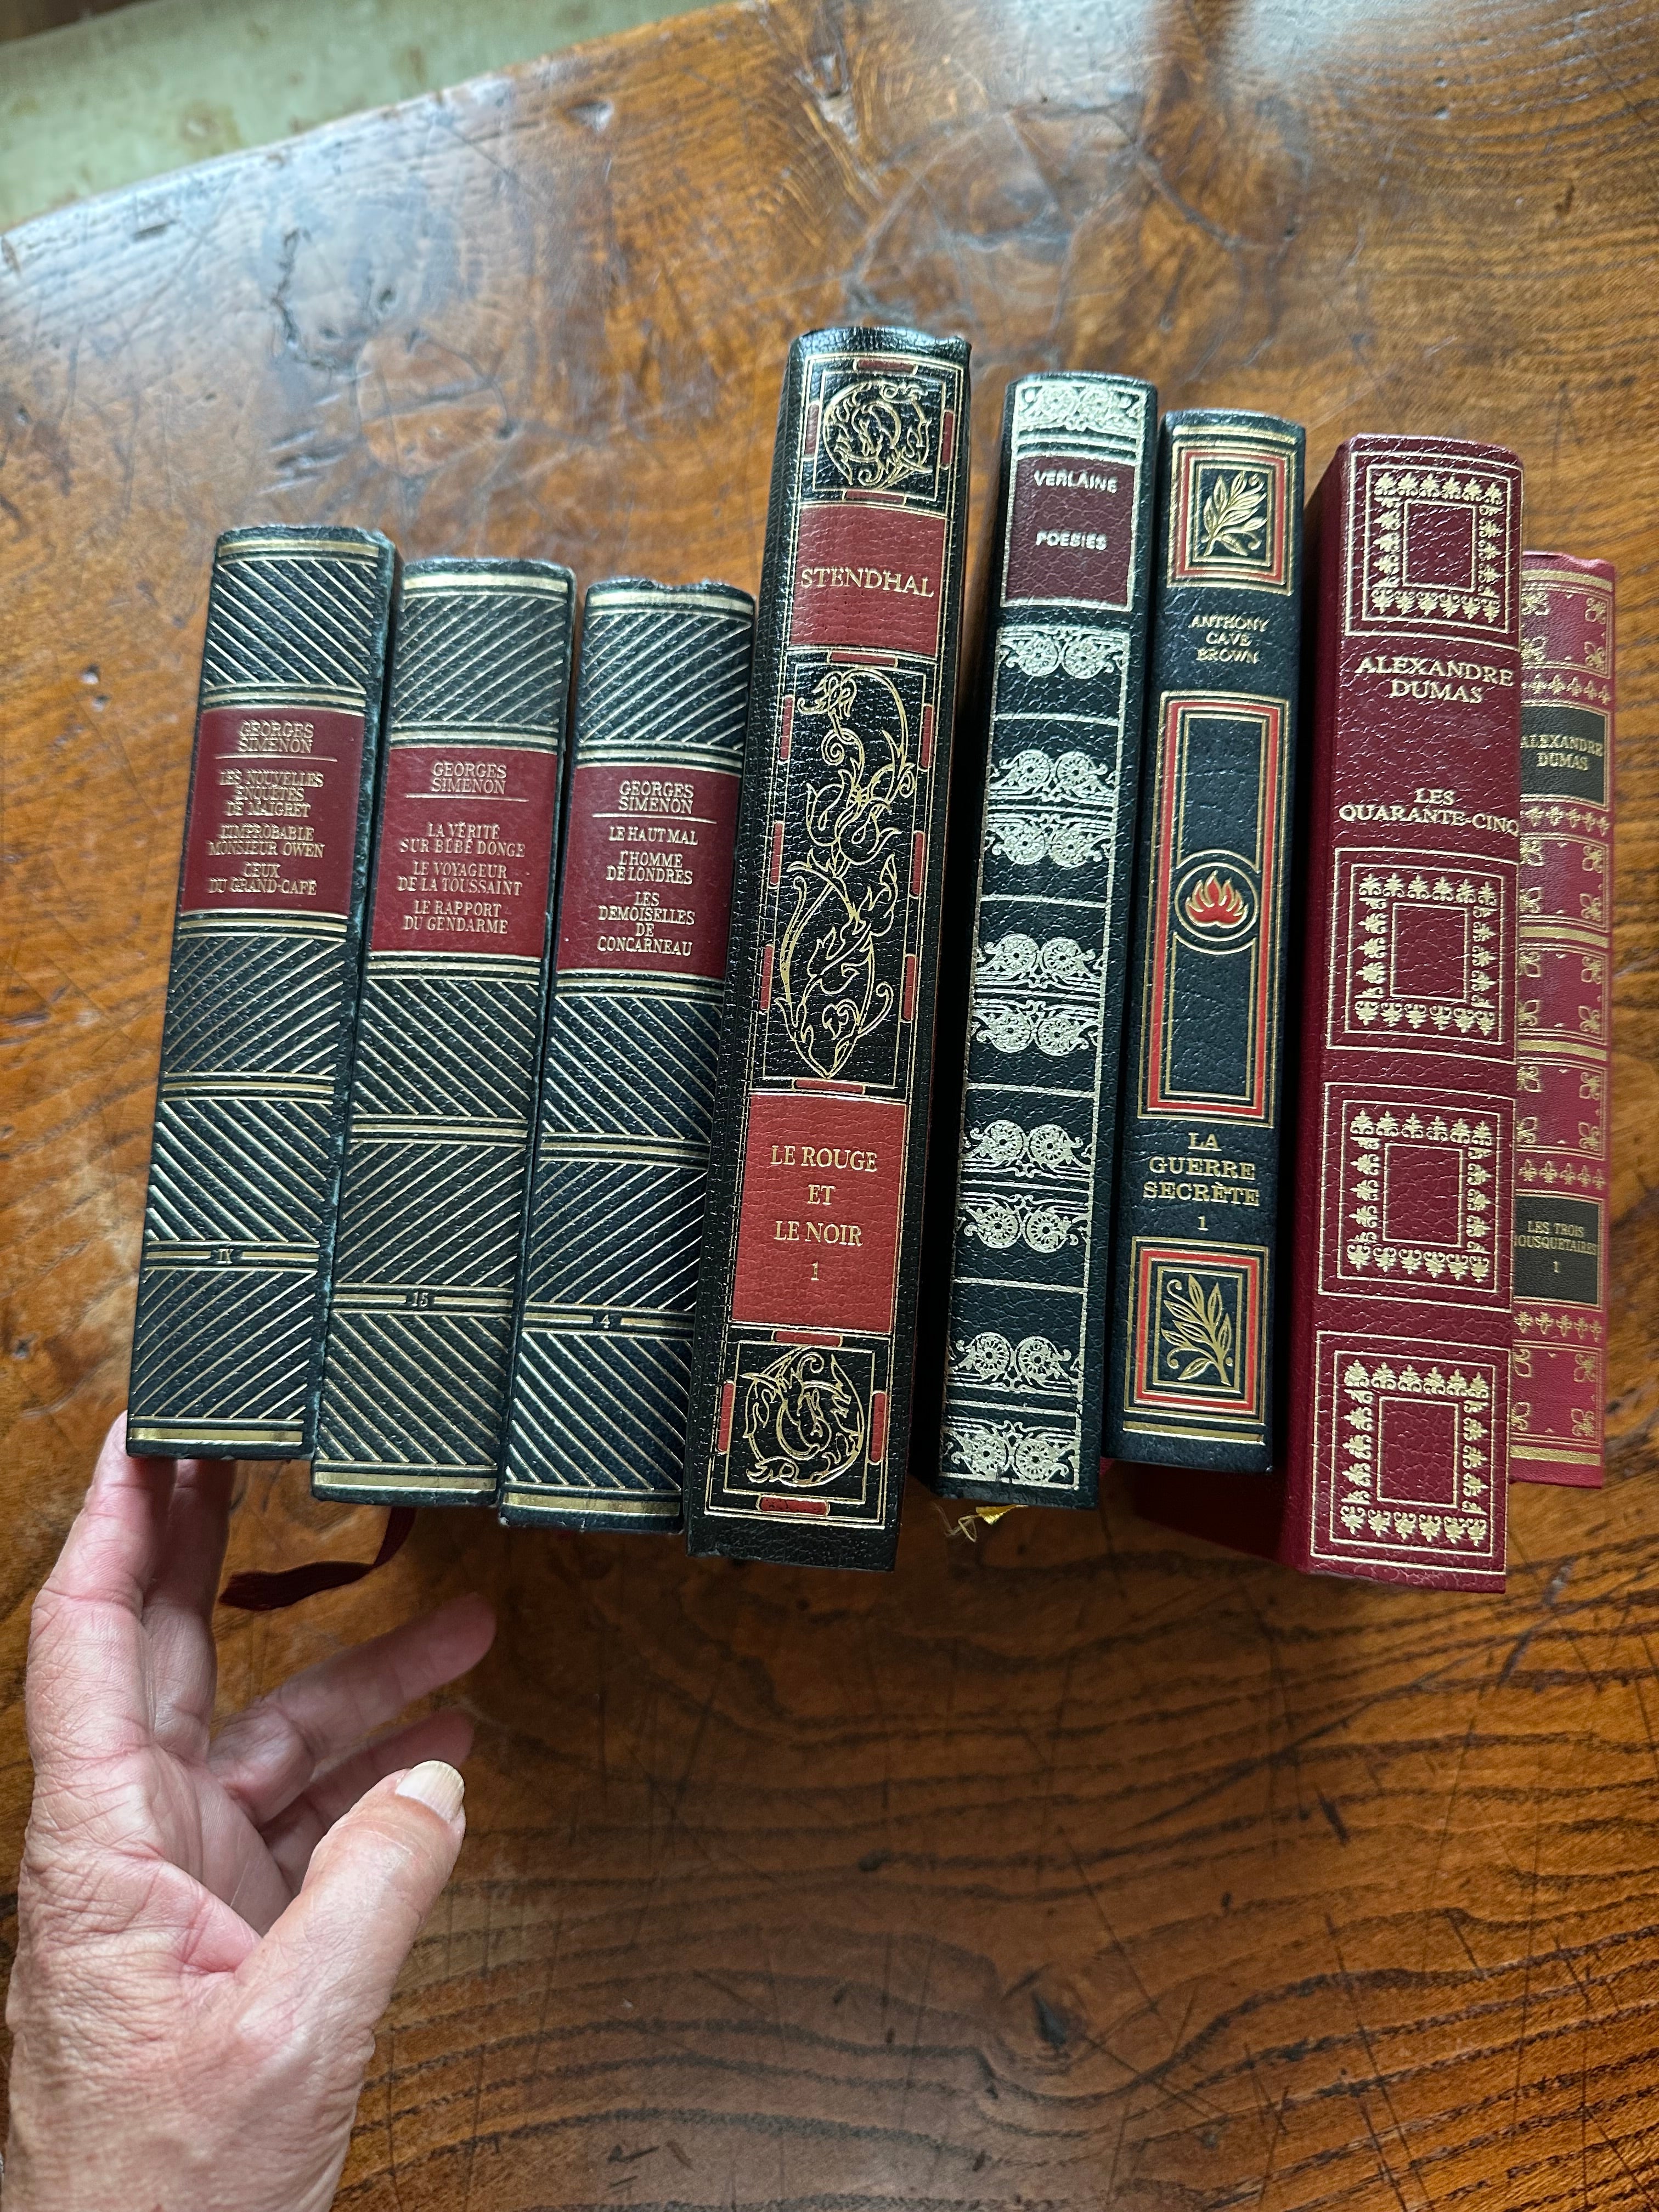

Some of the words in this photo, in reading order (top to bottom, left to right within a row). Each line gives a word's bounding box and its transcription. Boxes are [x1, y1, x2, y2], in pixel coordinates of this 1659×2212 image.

[1034, 469, 1118, 493] VERLAINE
[801, 566, 934, 597] STENDHAL
[1188, 613, 1271, 632] ANTHONY
[1206, 630, 1252, 646] CAVE
[1196, 646, 1260, 664] BROWN
[1355, 656, 1515, 686] ALEXANDRE
[1389, 679, 1483, 703] DUMAS
[239, 720, 314, 738] GEORGES
[238, 737, 313, 753] SIMENON
[431, 761, 507, 778] GEORGES
[1536, 751, 1589, 771] DUMAS
[218, 769, 242, 785] LES
[246, 769, 324, 787] NOUVELLES
[431, 777, 506, 794] SIMENON
[619, 780, 694, 798] GEORGES
[1413, 788, 1455, 805] LES
[225, 800, 244, 816] DE
[247, 800, 311, 817] MAIGRET
[618, 797, 693, 814] SIMENON
[427, 822, 445, 837] LA
[1339, 804, 1520, 837] QUARANTE-CINQ
[608, 826, 625, 841] LE
[628, 826, 667, 842] HAUT
[667, 829, 698, 845] MAL
[207, 840, 278, 855] MONSIEUR
[281, 842, 325, 857] OWEN
[400, 838, 430, 853] SUR
[477, 840, 526, 857] DONGE
[243, 862, 280, 878] CEUX
[413, 861, 429, 875] LE
[433, 861, 507, 879] VOYAGEUR
[606, 865, 625, 881] DE
[628, 866, 693, 885] LONDRES
[208, 878, 228, 893] DU
[397, 876, 417, 891] DE
[421, 878, 438, 891] LA
[442, 878, 523, 896] TOUSSAINT
[635, 891, 659, 906] LES
[413, 900, 431, 915] LE
[435, 900, 502, 917] RAPPORT
[598, 905, 695, 926] DEMOISELLES
[403, 915, 424, 930] DU
[428, 917, 508, 934] GENDARME
[635, 922, 654, 937] DE
[597, 936, 692, 956] CONCARNEAU
[1188, 1132, 1222, 1151] LA
[770, 1145, 795, 1165] LE
[801, 1146, 877, 1172] ROUGE
[1149, 1156, 1255, 1180] GUERRE
[807, 1184, 836, 1205] ET
[1143, 1181, 1260, 1206] SECRÈTE
[1198, 1215, 1209, 1231] 1
[1527, 1221, 1550, 1234] LES
[1554, 1222, 1584, 1238] TROIS
[774, 1221, 799, 1240] LE
[805, 1222, 863, 1246] NOIR
[811, 1261, 819, 1280] 1
[412, 1291, 428, 1307] 15
[600, 1314, 610, 1328] 4
